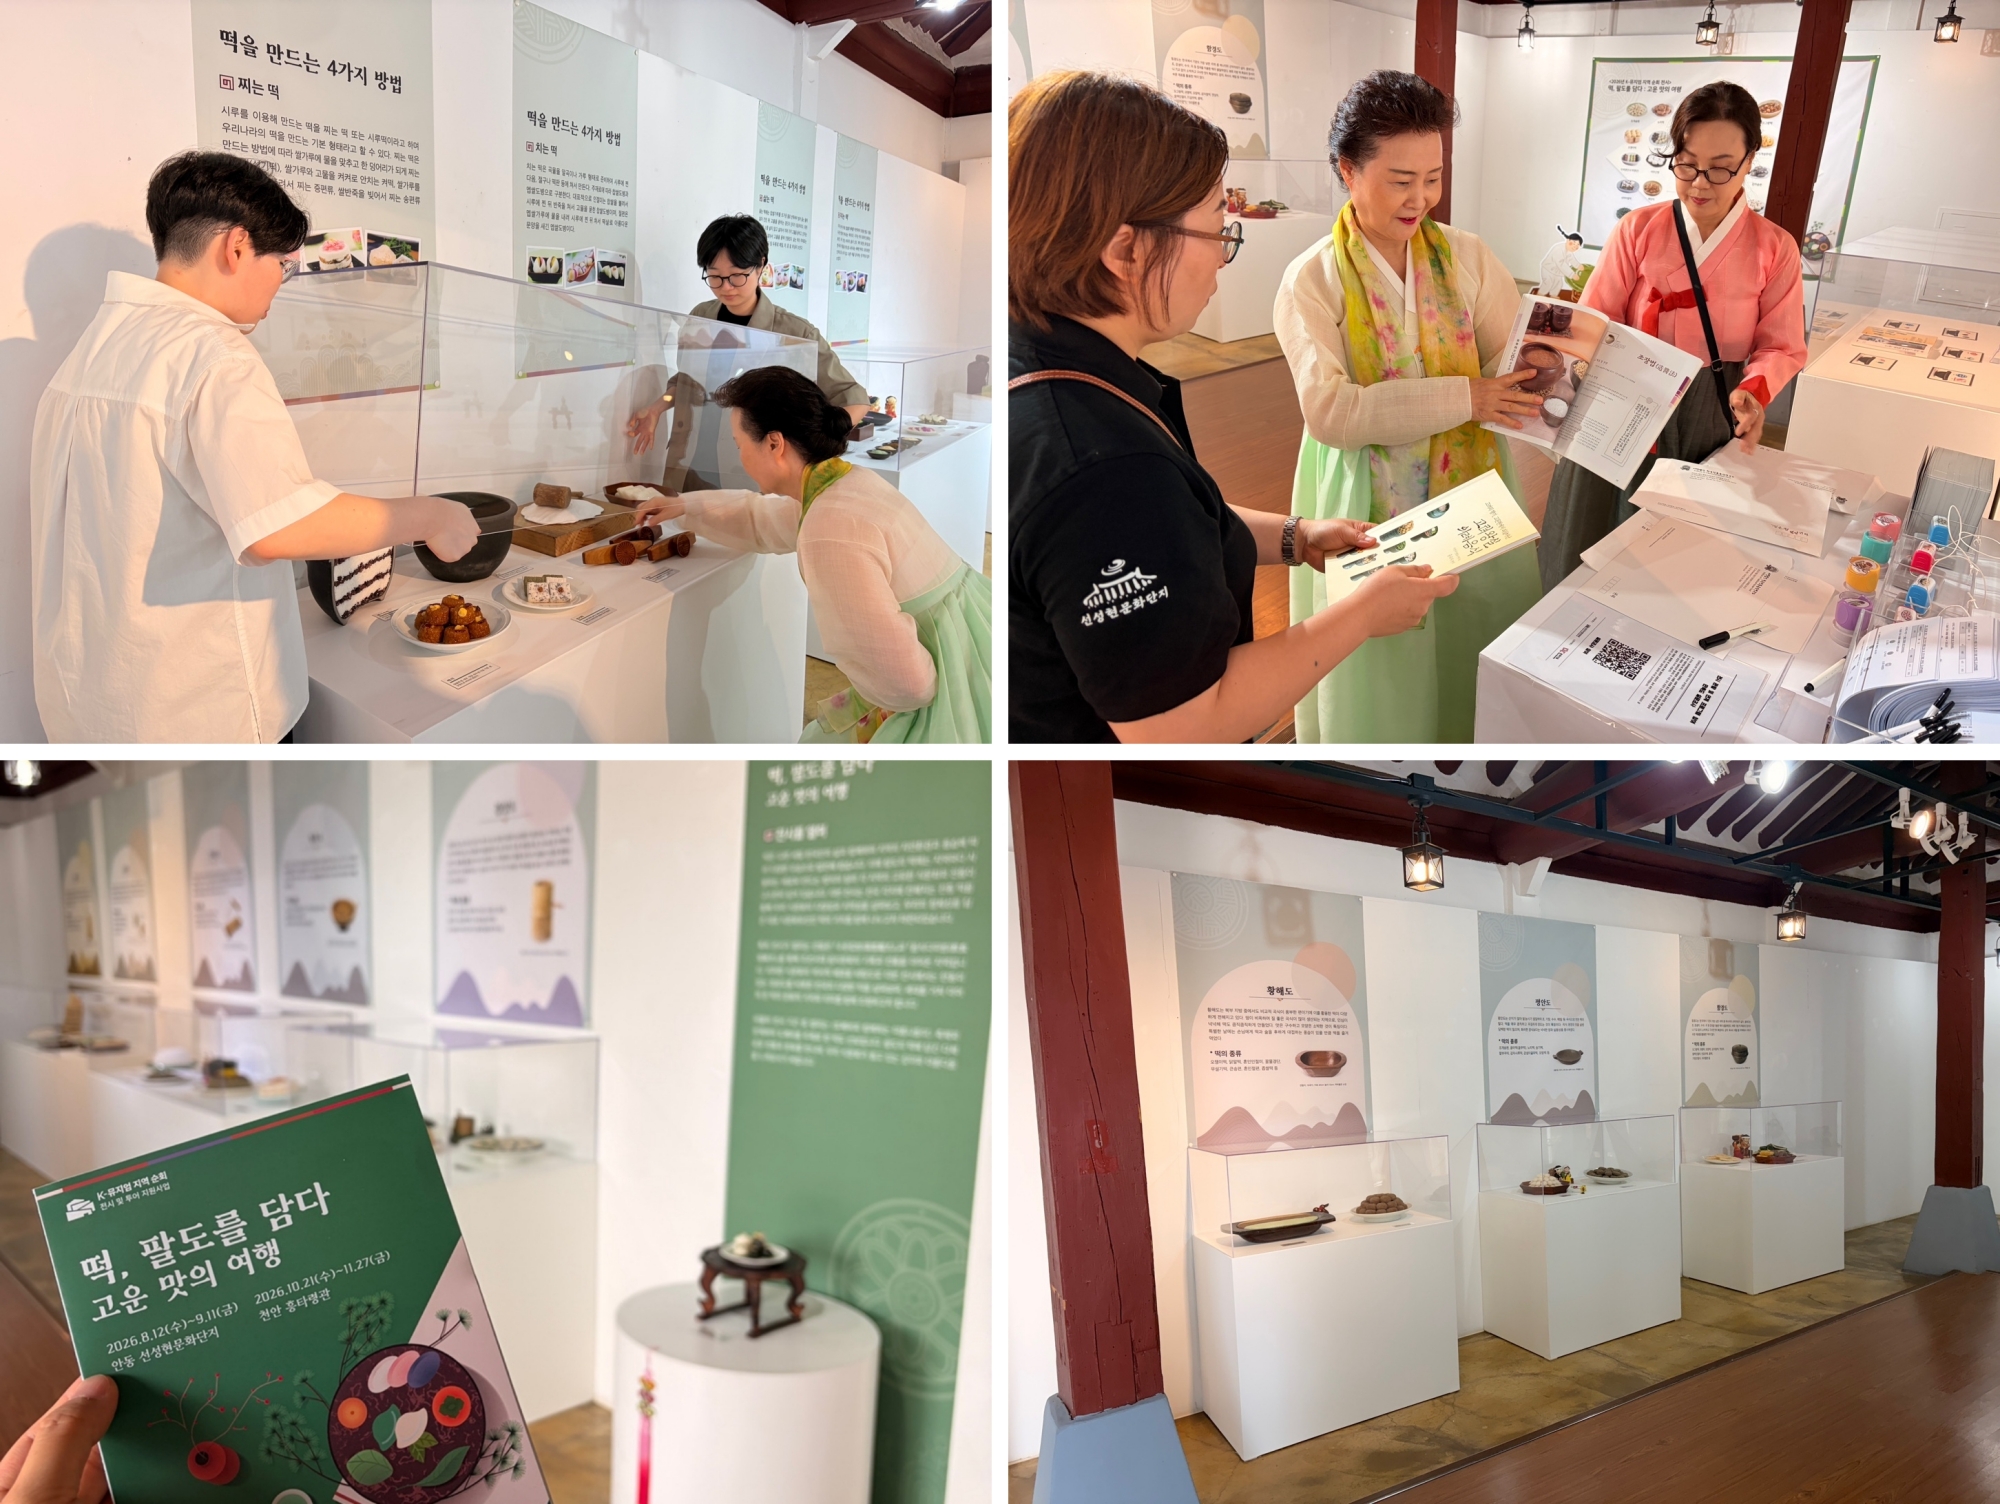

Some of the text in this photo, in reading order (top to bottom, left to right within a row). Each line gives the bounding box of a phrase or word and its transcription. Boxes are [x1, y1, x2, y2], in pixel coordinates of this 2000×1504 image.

[219, 29, 402, 94] 떡을 만드는 4가지 방법
[238, 77, 280, 100] 찌는 떡
[221, 106, 249, 119] 시루를
[253, 111, 277, 124] 이용해
[281, 117, 302, 130] 만드는
[306, 122, 320, 133] 떡을
[324, 126, 338, 136] 찌는
[341, 128, 348, 138] 떡
[351, 130, 365, 140] 또는
[527, 111, 621, 146] 떡을 만드는 4가지 방법
[222, 123, 266, 138] 우리나라의
[270, 130, 285, 141] 떡을
[288, 134, 308, 146] 만드는
[312, 138, 326, 149] 기본
[329, 141, 356, 153] 형태라고
[360, 146, 366, 155] 할
[394, 152, 405, 162] 찌는
[408, 155, 419, 164] 떡은
[222, 140, 419, 178] 만드는 방법에 따라 쌀가루에 물을 맞추고 한 덩어리가 되게 찌는
[536, 142, 557, 156] 치는 떡
[285, 164, 313, 177] 쌀가루와
[316, 169, 335, 180] 고물을
[338, 173, 358, 182] 켜켜로
[360, 176, 379, 186] 안치는
[397, 180, 420, 192] 쌀가루를
[297, 181, 311, 191] 찌는
[338, 187, 364, 198] 쌀반죽을
[368, 191, 386, 201] 빚어서
[389, 193, 401, 202] 찌는
[1081, 586, 1169, 626] 선성현문화단지
[1266, 986, 1293, 996] 황해도
[97, 1171, 167, 1201] K-뮤지엄 지역 순회
[100, 1182, 170, 1211] 전시 및 투어 지원사업
[80, 1182, 331, 1285] 떡, 팔도를 담다
[92, 1238, 281, 1322] 고운 맛의 여행
[254, 1250, 391, 1305] 2026.10.21(수)~11.27(금)
[259, 1288, 331, 1321] 천안 흥타령관
[106, 1302, 238, 1354] 2026.8.12(수)~9.11(금)
[111, 1326, 220, 1372] 안동 선성현문화단지
